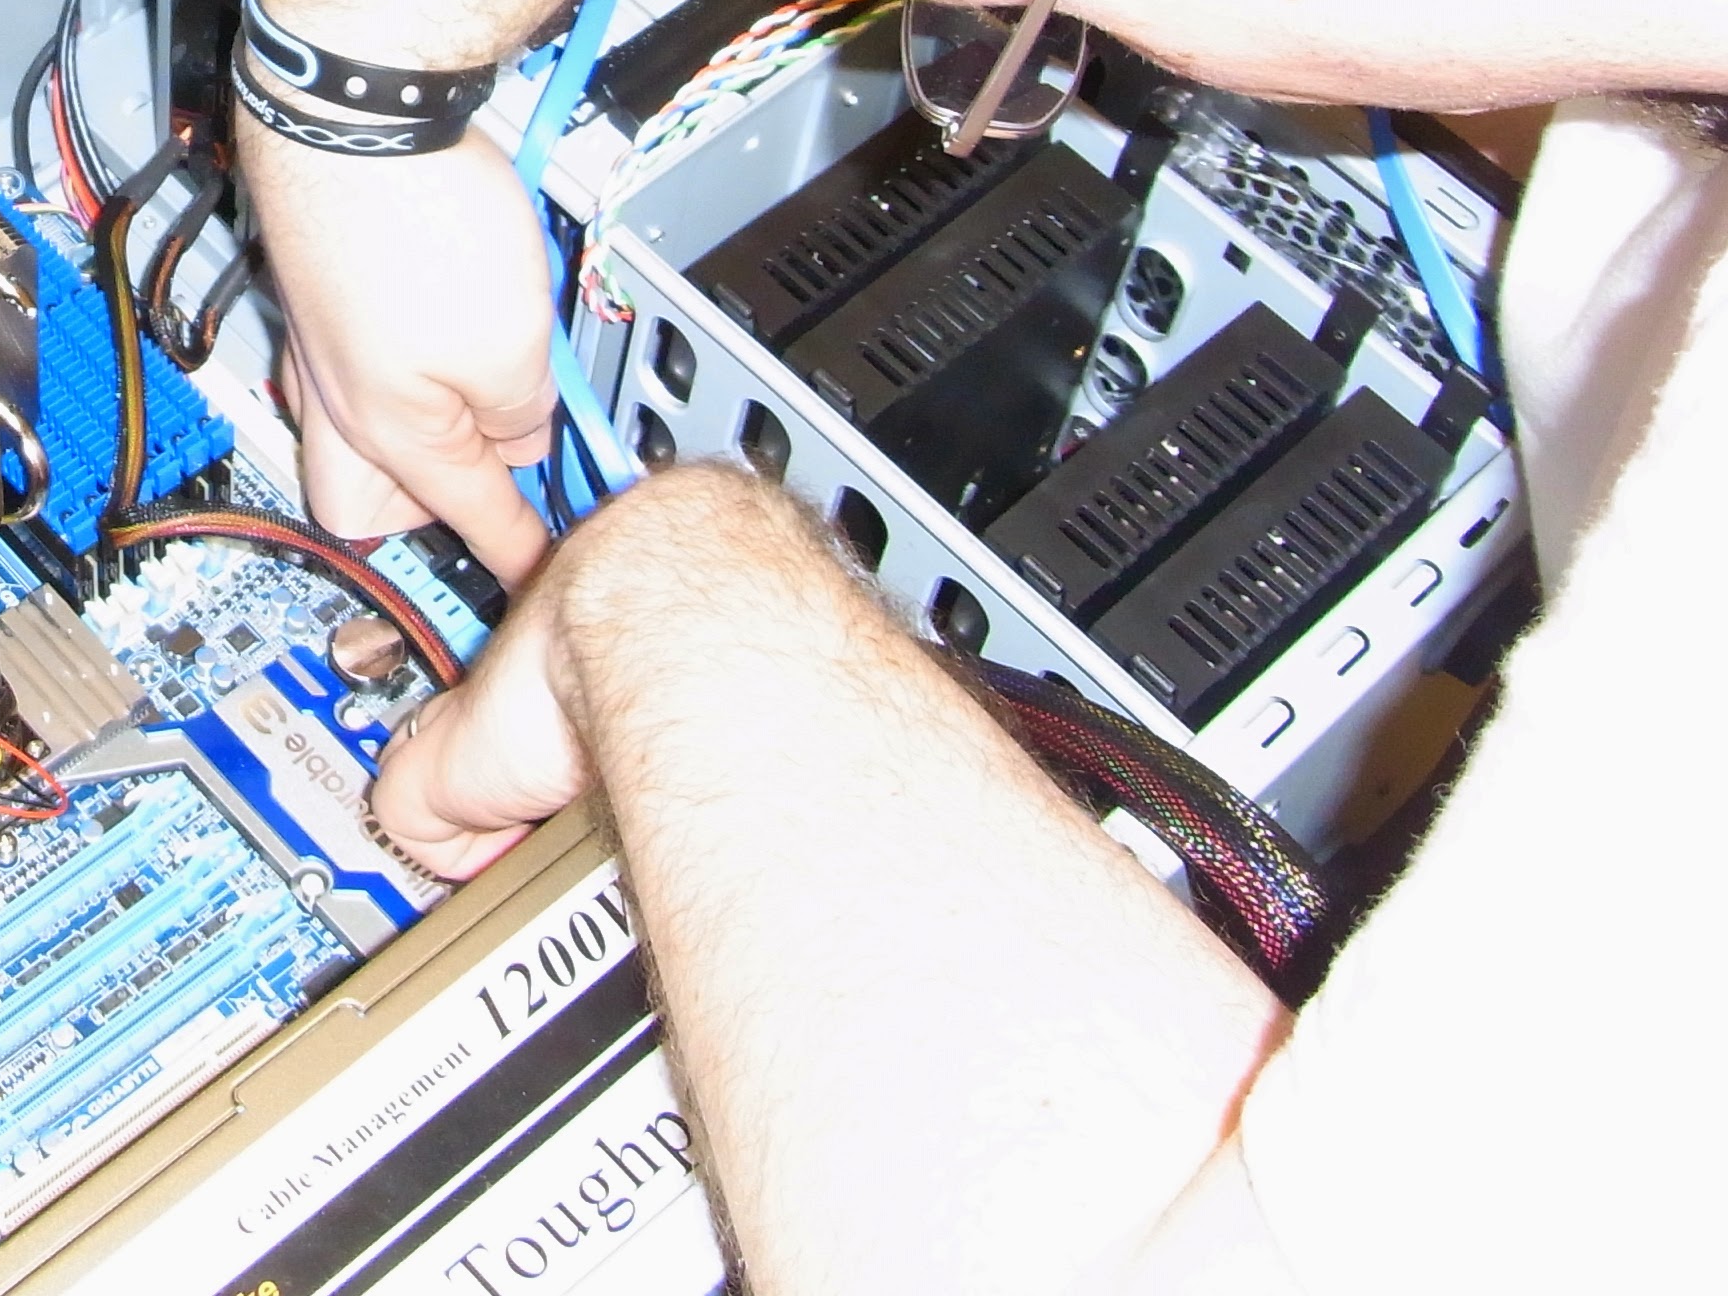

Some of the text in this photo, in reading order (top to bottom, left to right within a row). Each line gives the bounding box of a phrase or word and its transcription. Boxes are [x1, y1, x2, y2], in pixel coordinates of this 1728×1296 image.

[242, 690, 286, 734] 3
[285, 733, 386, 846] Durable
[237, 1172, 313, 1234] Cable
[312, 1040, 472, 1175] Management
